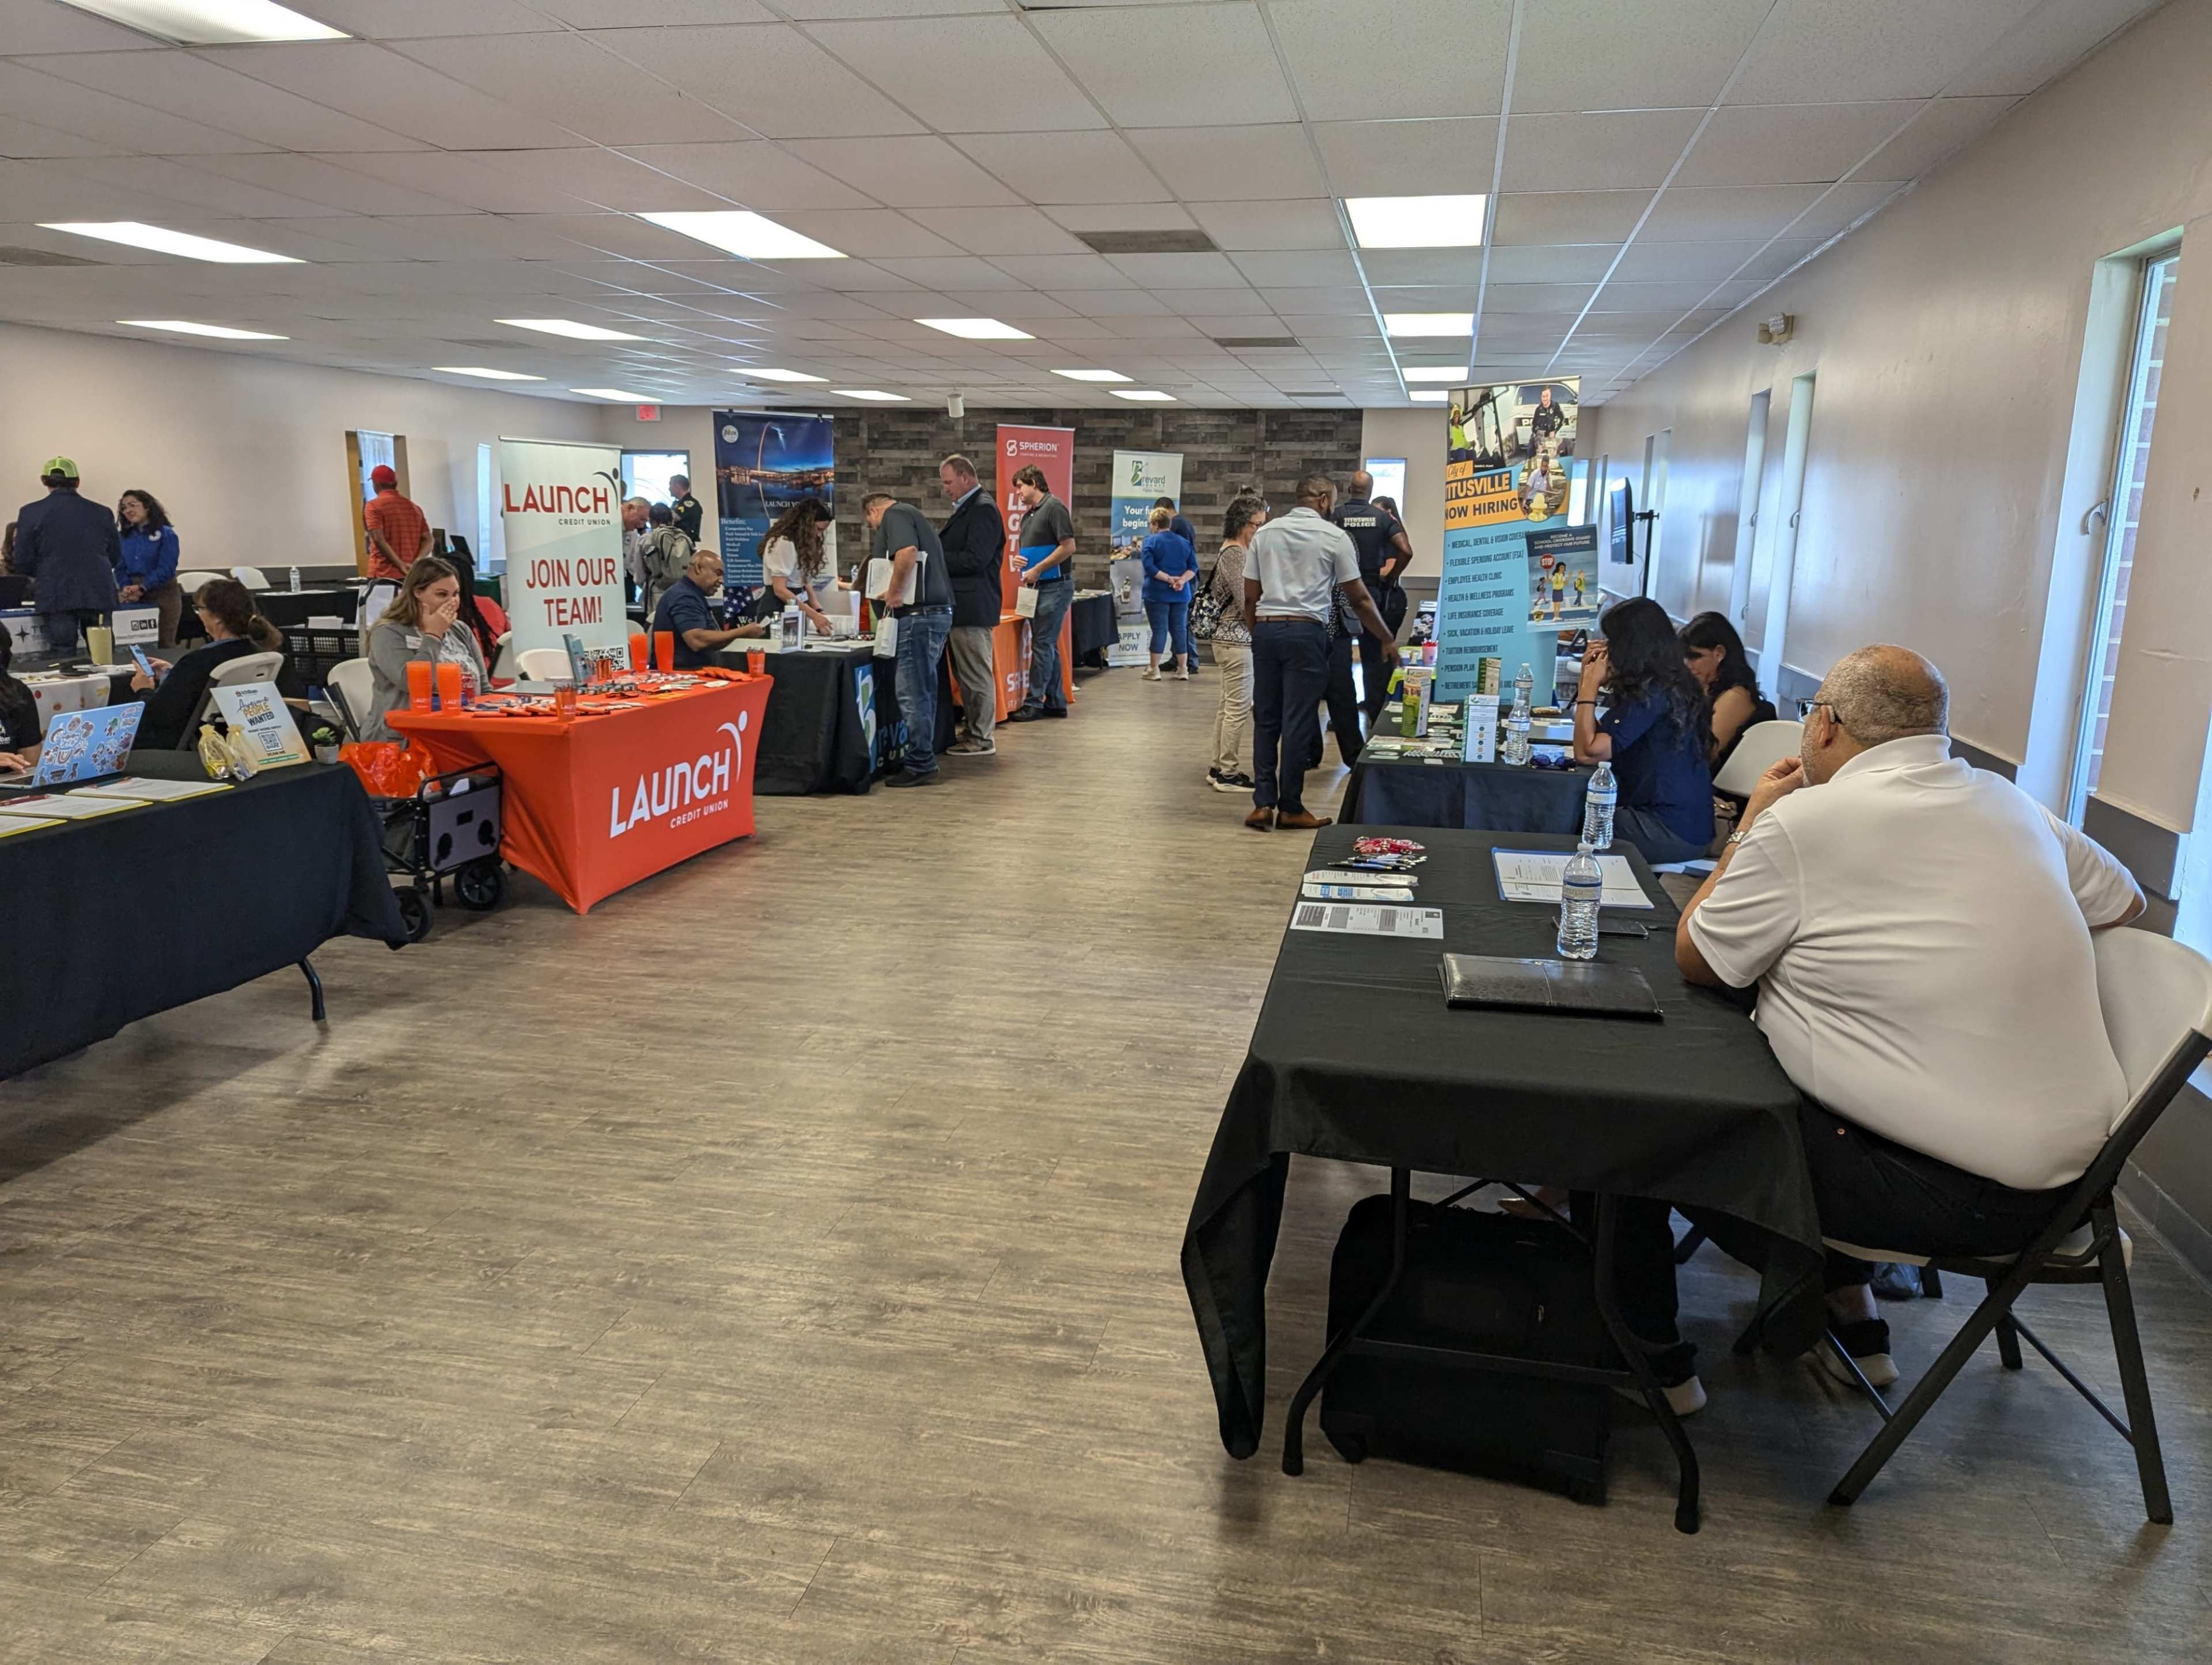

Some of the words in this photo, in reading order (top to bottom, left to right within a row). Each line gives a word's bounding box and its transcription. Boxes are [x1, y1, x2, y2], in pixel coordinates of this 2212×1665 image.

[1020, 442, 1058, 452] SPHERION
[1448, 465, 1457, 478] City
[1459, 463, 1467, 476] of
[1124, 506, 1143, 515] Your
[1473, 498, 1517, 516] HIRING
[1123, 518, 1148, 530] begins
[1474, 537, 1490, 547] DENTAL
[1495, 534, 1508, 543] VISION
[1449, 557, 1470, 567] FLEXIBLE
[1471, 555, 1493, 564] SPENDING
[1493, 552, 1512, 563] ACCOUNT
[1541, 557, 1554, 566] STOP
[527, 559, 570, 589] JOIN
[577, 558, 618, 586] OUR
[1448, 575, 1471, 585] EMPLOYEE
[1472, 574, 1488, 582] HEALTH
[1488, 572, 1502, 581] CLINIC
[1448, 593, 1464, 602] HEALTH
[1465, 593, 1468, 601] &
[1469, 591, 1492, 600] WELLNESS
[1493, 589, 1514, 598] PROGRAMS
[544, 596, 603, 627] TEAM!
[1448, 612, 1457, 620] LIFE
[1458, 610, 1482, 619] INSURANCE
[1483, 608, 1504, 617] COVERAGE
[1460, 628, 1480, 637] VACATION
[1481, 628, 1484, 636] &
[1484, 626, 1502, 635] HOLIDAY
[1502, 625, 1514, 634] LEAVE
[1119, 643, 1139, 651] NOW
[1463, 645, 1498, 654] REIMBURSEMENT
[1445, 681, 1470, 689] RETIREMENT
[243, 703, 271, 718] PEOPLE
[247, 711, 275, 726] WANTED
[670, 808, 701, 829] CREDIT
[704, 799, 729, 816] UNION
